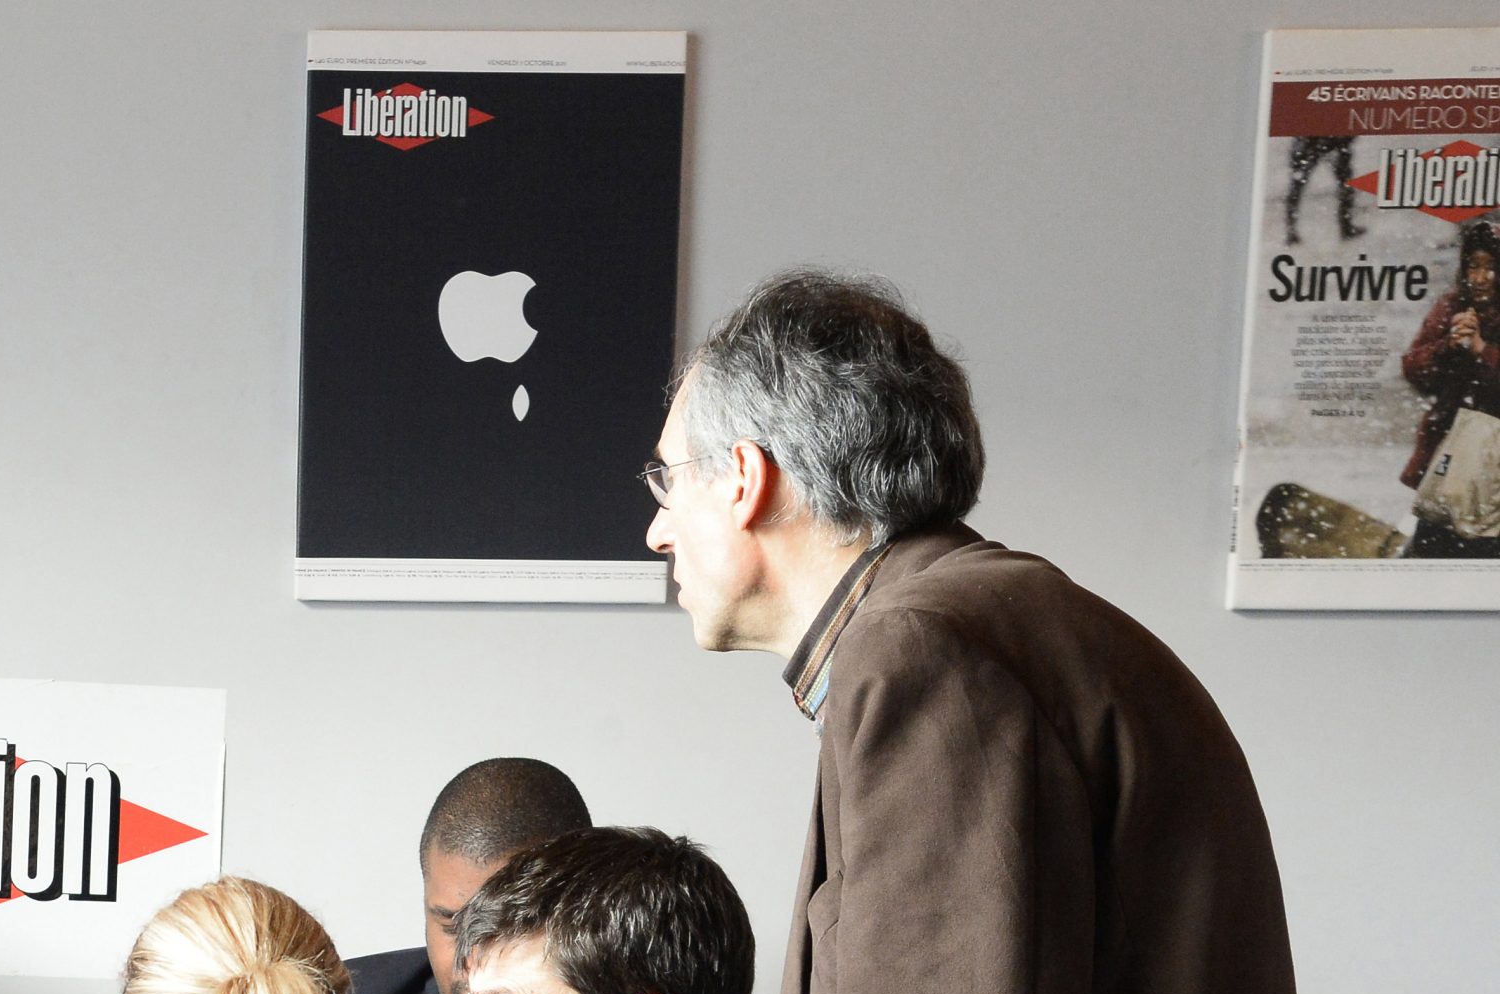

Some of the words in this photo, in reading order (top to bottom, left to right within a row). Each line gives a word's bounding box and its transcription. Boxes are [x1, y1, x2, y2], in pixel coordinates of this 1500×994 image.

[342, 88, 468, 138] Libération
[1307, 86, 1331, 102] 45
[1333, 84, 1416, 102] ÉCRIVAINS
[1419, 84, 1500, 100] RACONTE
[1349, 101, 1468, 130] NUMÉRO
[1378, 147, 1500, 209] Libérati
[1268, 254, 1429, 302] Survivre
